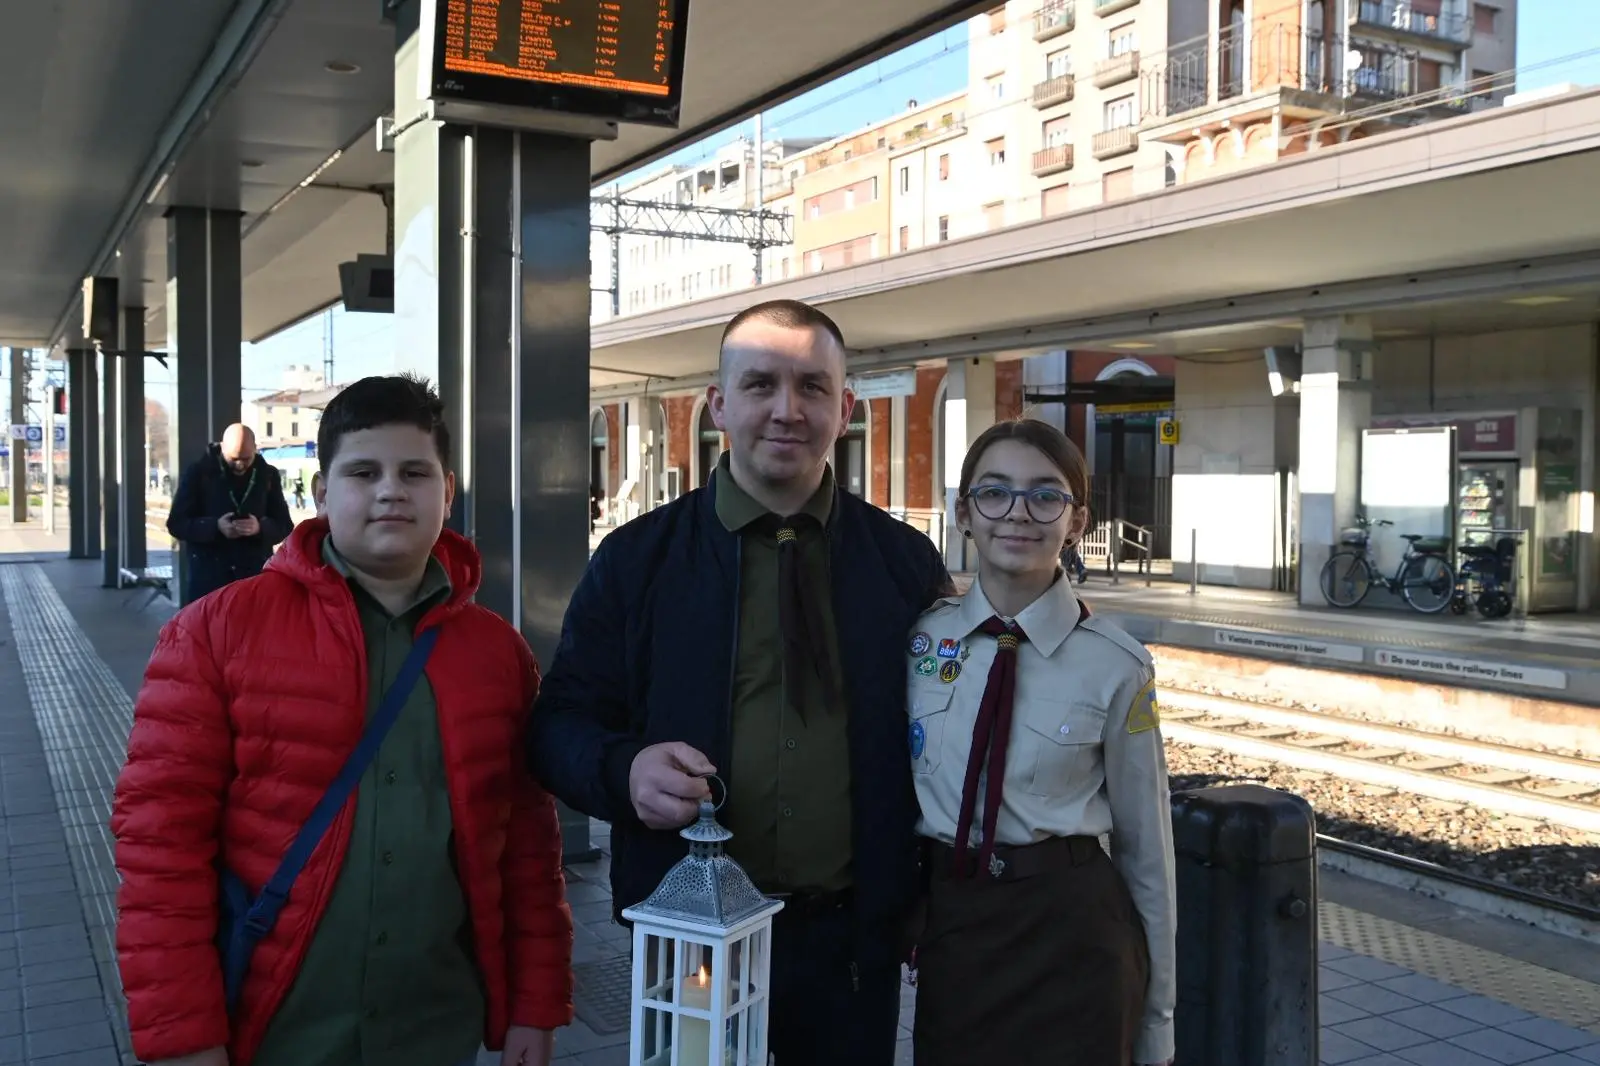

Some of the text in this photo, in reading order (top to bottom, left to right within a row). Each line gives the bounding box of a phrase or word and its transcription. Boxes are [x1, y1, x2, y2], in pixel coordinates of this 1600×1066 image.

[1391, 655, 1524, 680] Do not cross the railway lines
